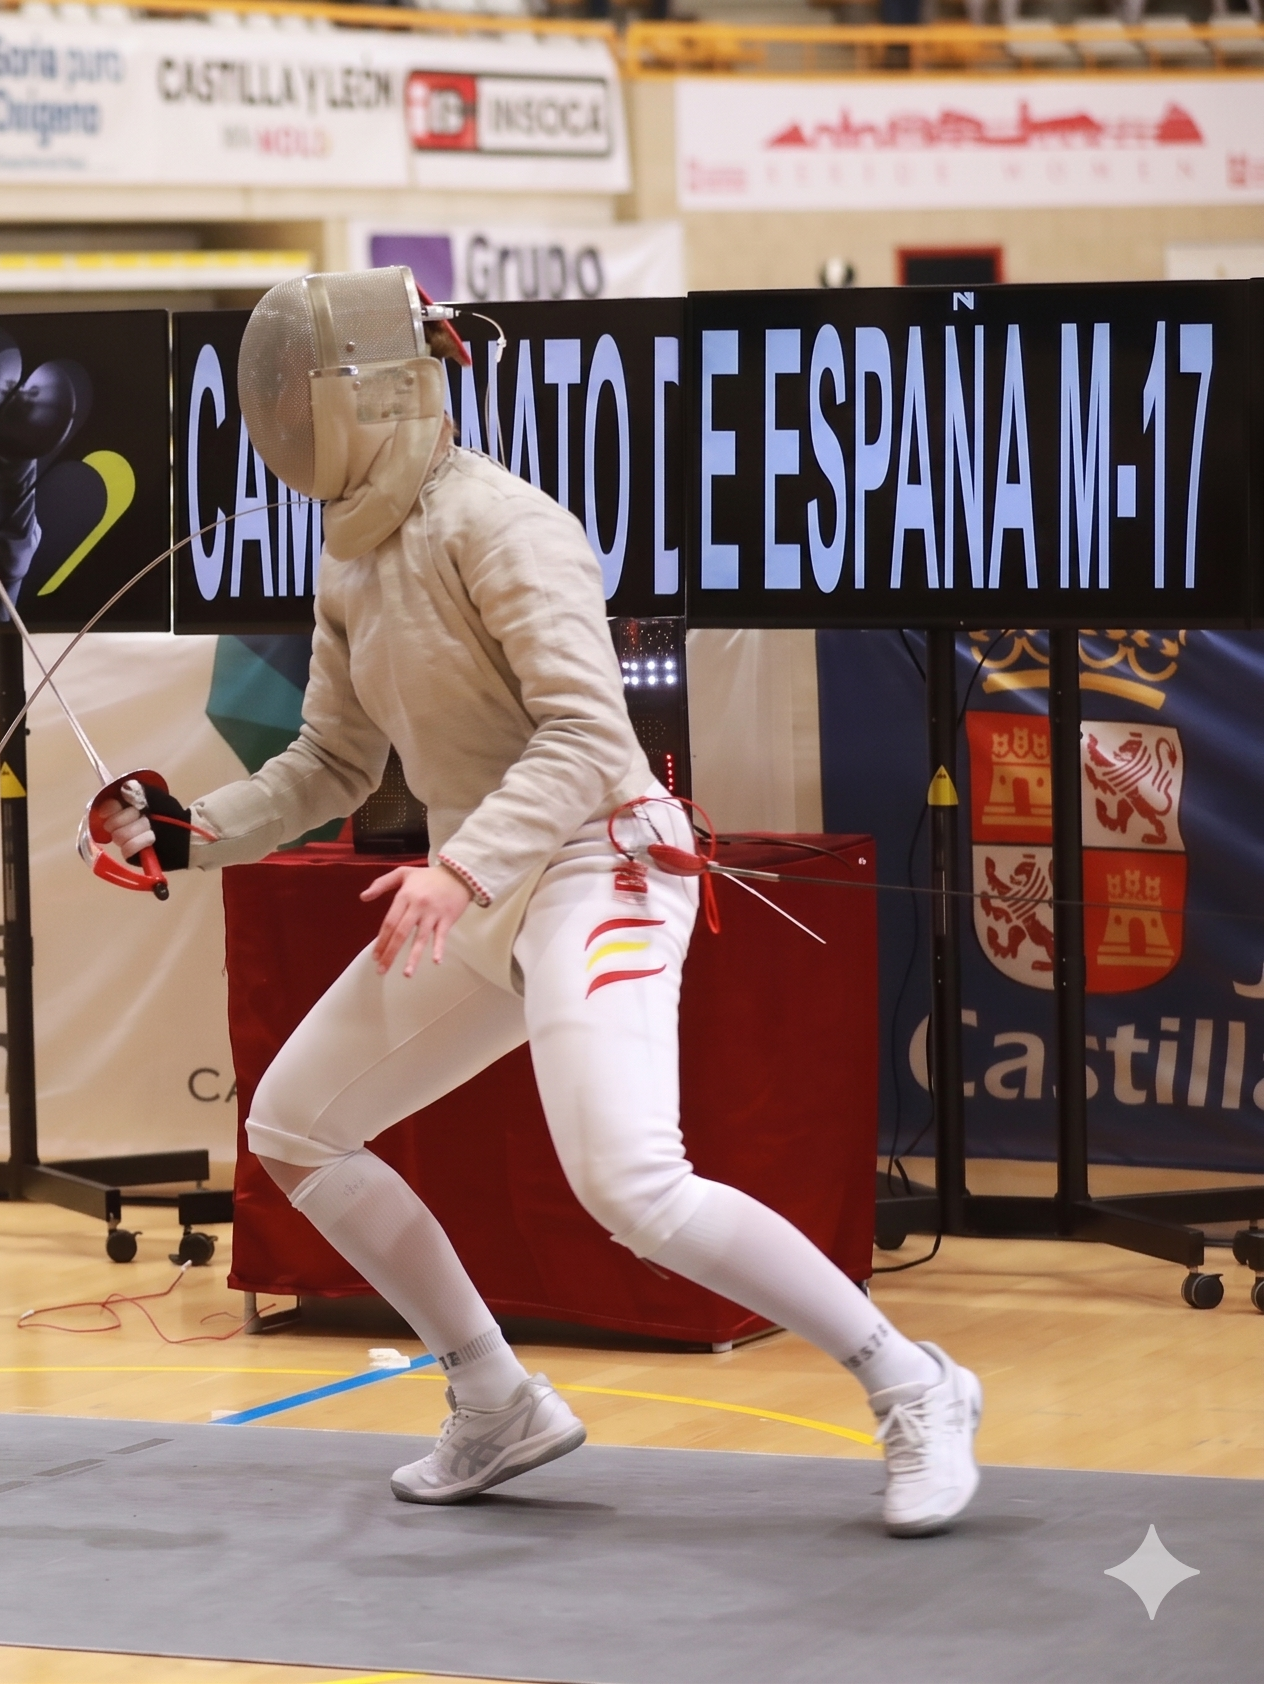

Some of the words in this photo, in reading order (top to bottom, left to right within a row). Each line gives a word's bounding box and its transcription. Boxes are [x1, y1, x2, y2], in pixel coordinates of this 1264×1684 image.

[156, 56, 298, 107] CASTILLA
[491, 95, 604, 138] INSOCA
[466, 235, 604, 301] Grupo
[764, 291, 1039, 594] ESPAÑA
[1060, 320, 1213, 589] M-17
[908, 1009, 1264, 1112] Catill
